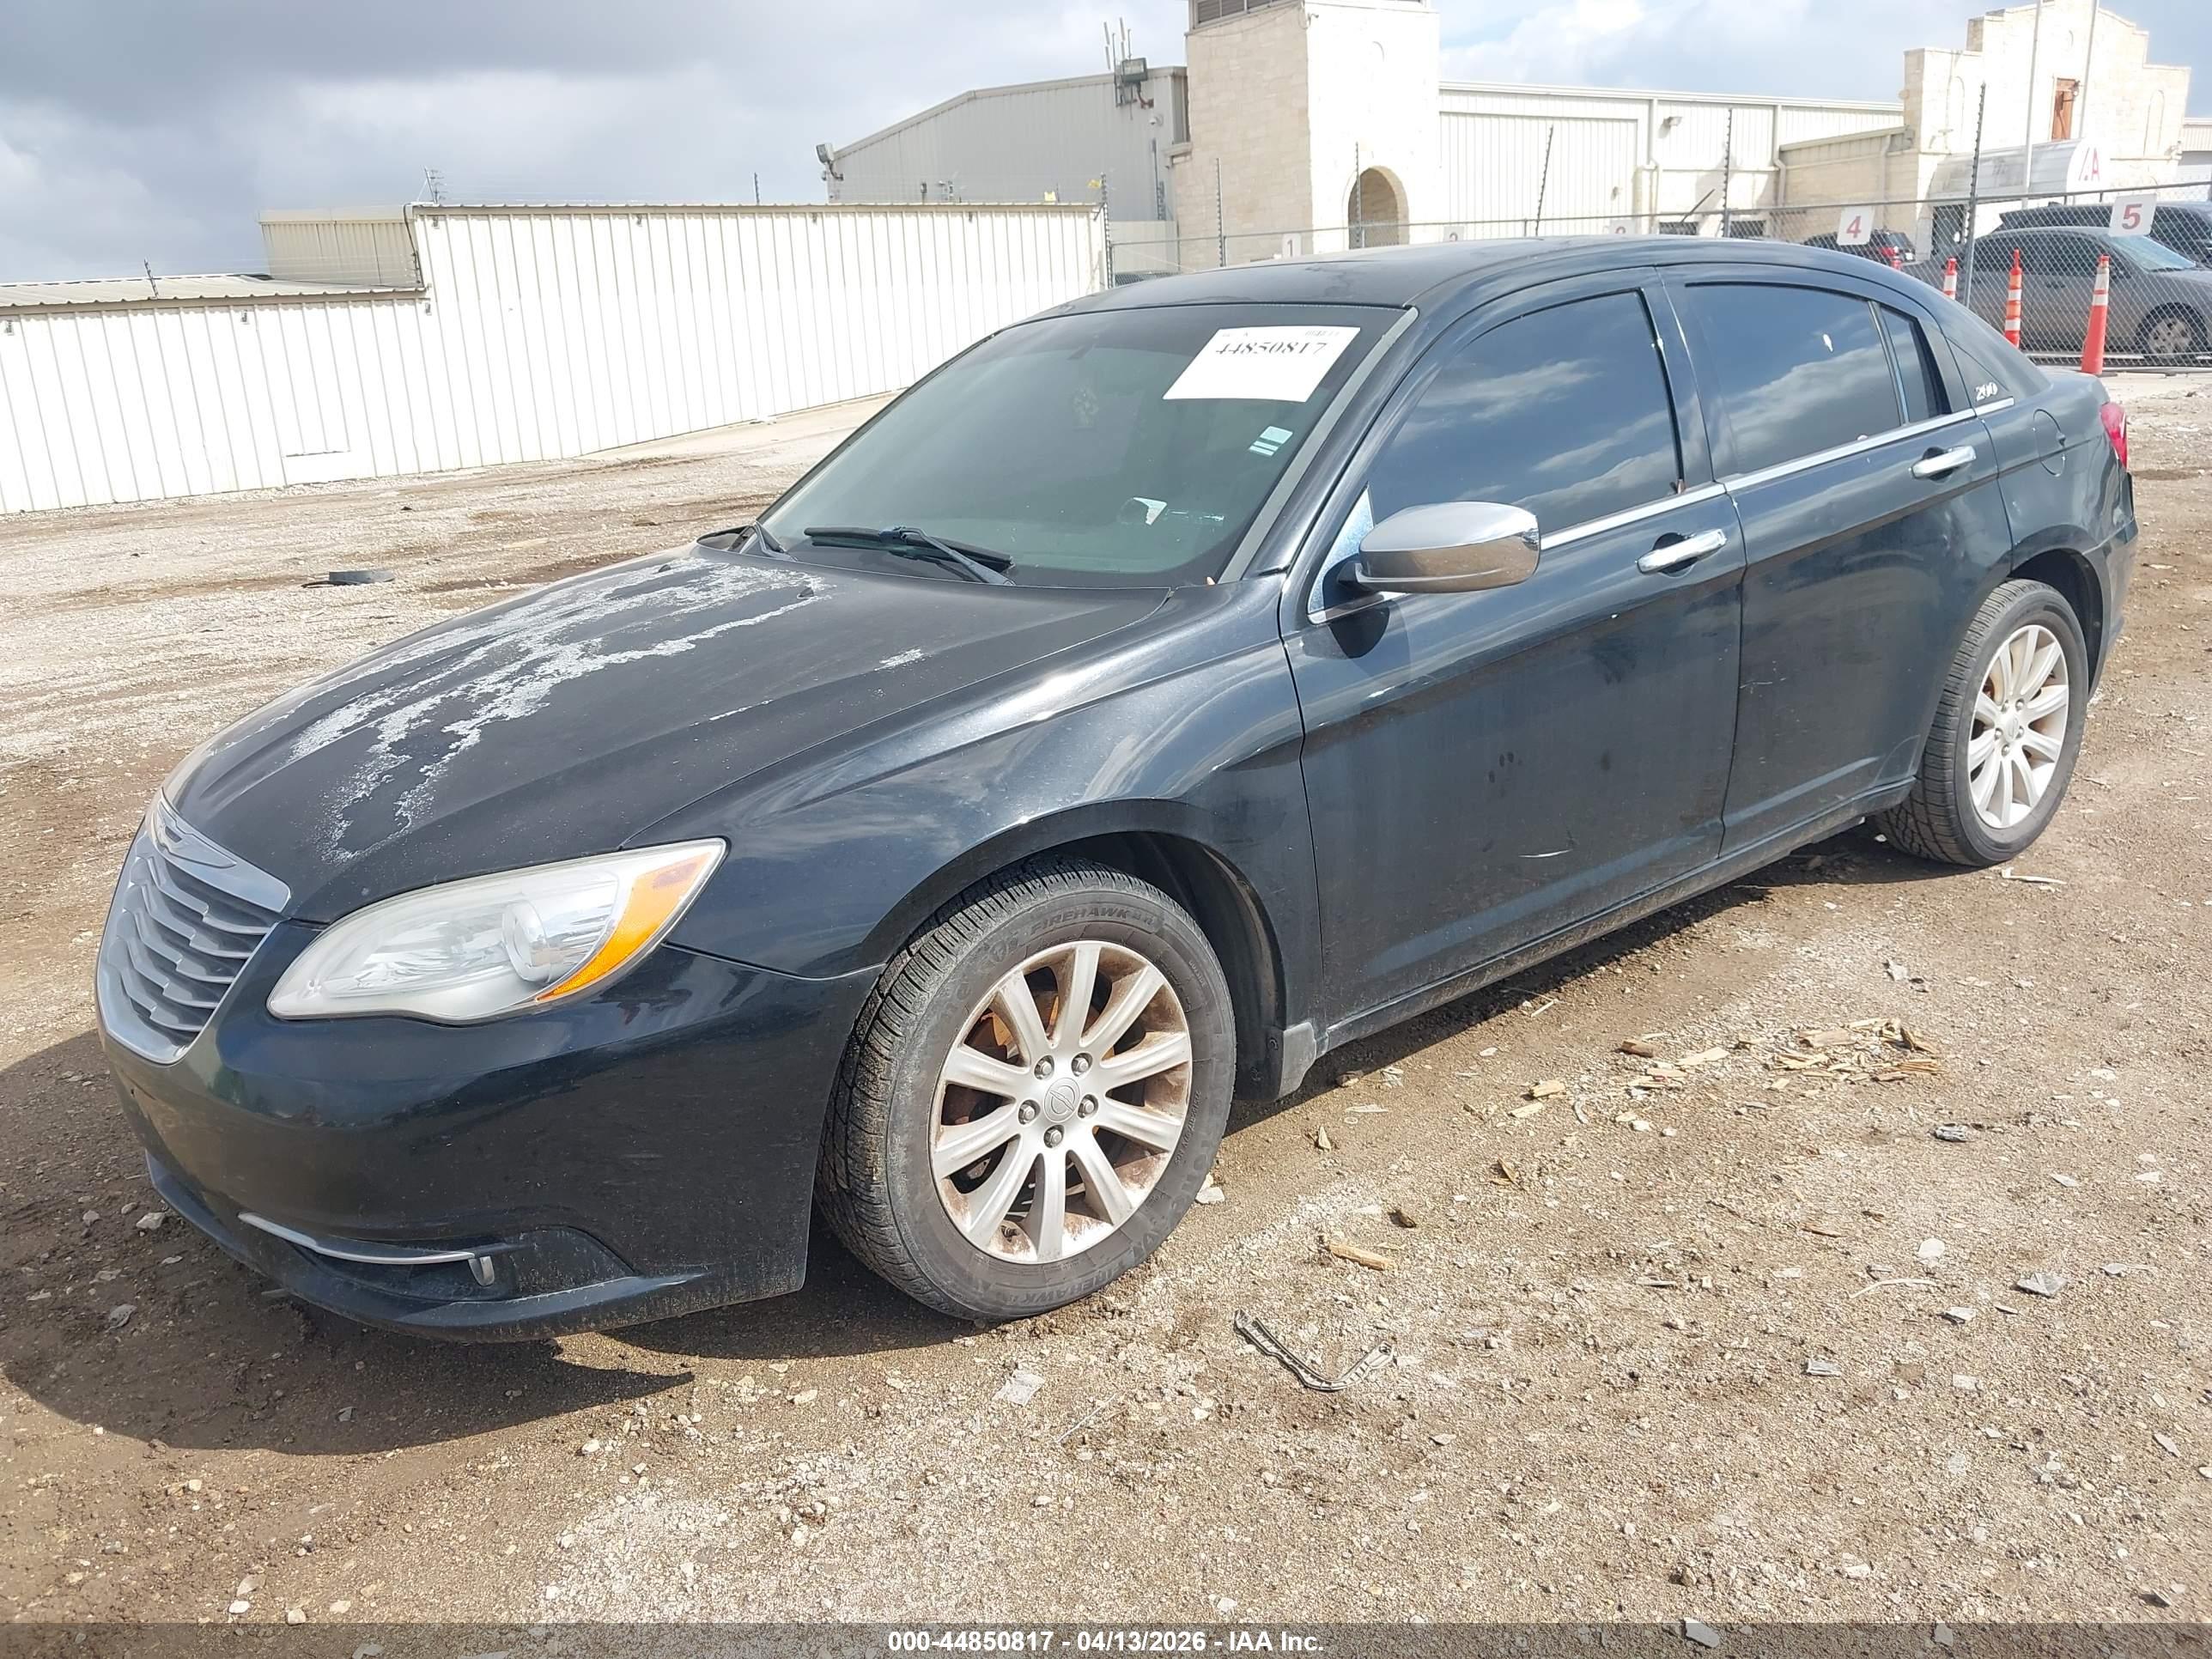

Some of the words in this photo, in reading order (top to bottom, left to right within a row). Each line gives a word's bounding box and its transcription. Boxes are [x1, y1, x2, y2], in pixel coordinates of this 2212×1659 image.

[1846, 216, 1862, 238] 4
[2122, 204, 2142, 229] 5
[1030, 906, 1127, 936] FIREHAWK
